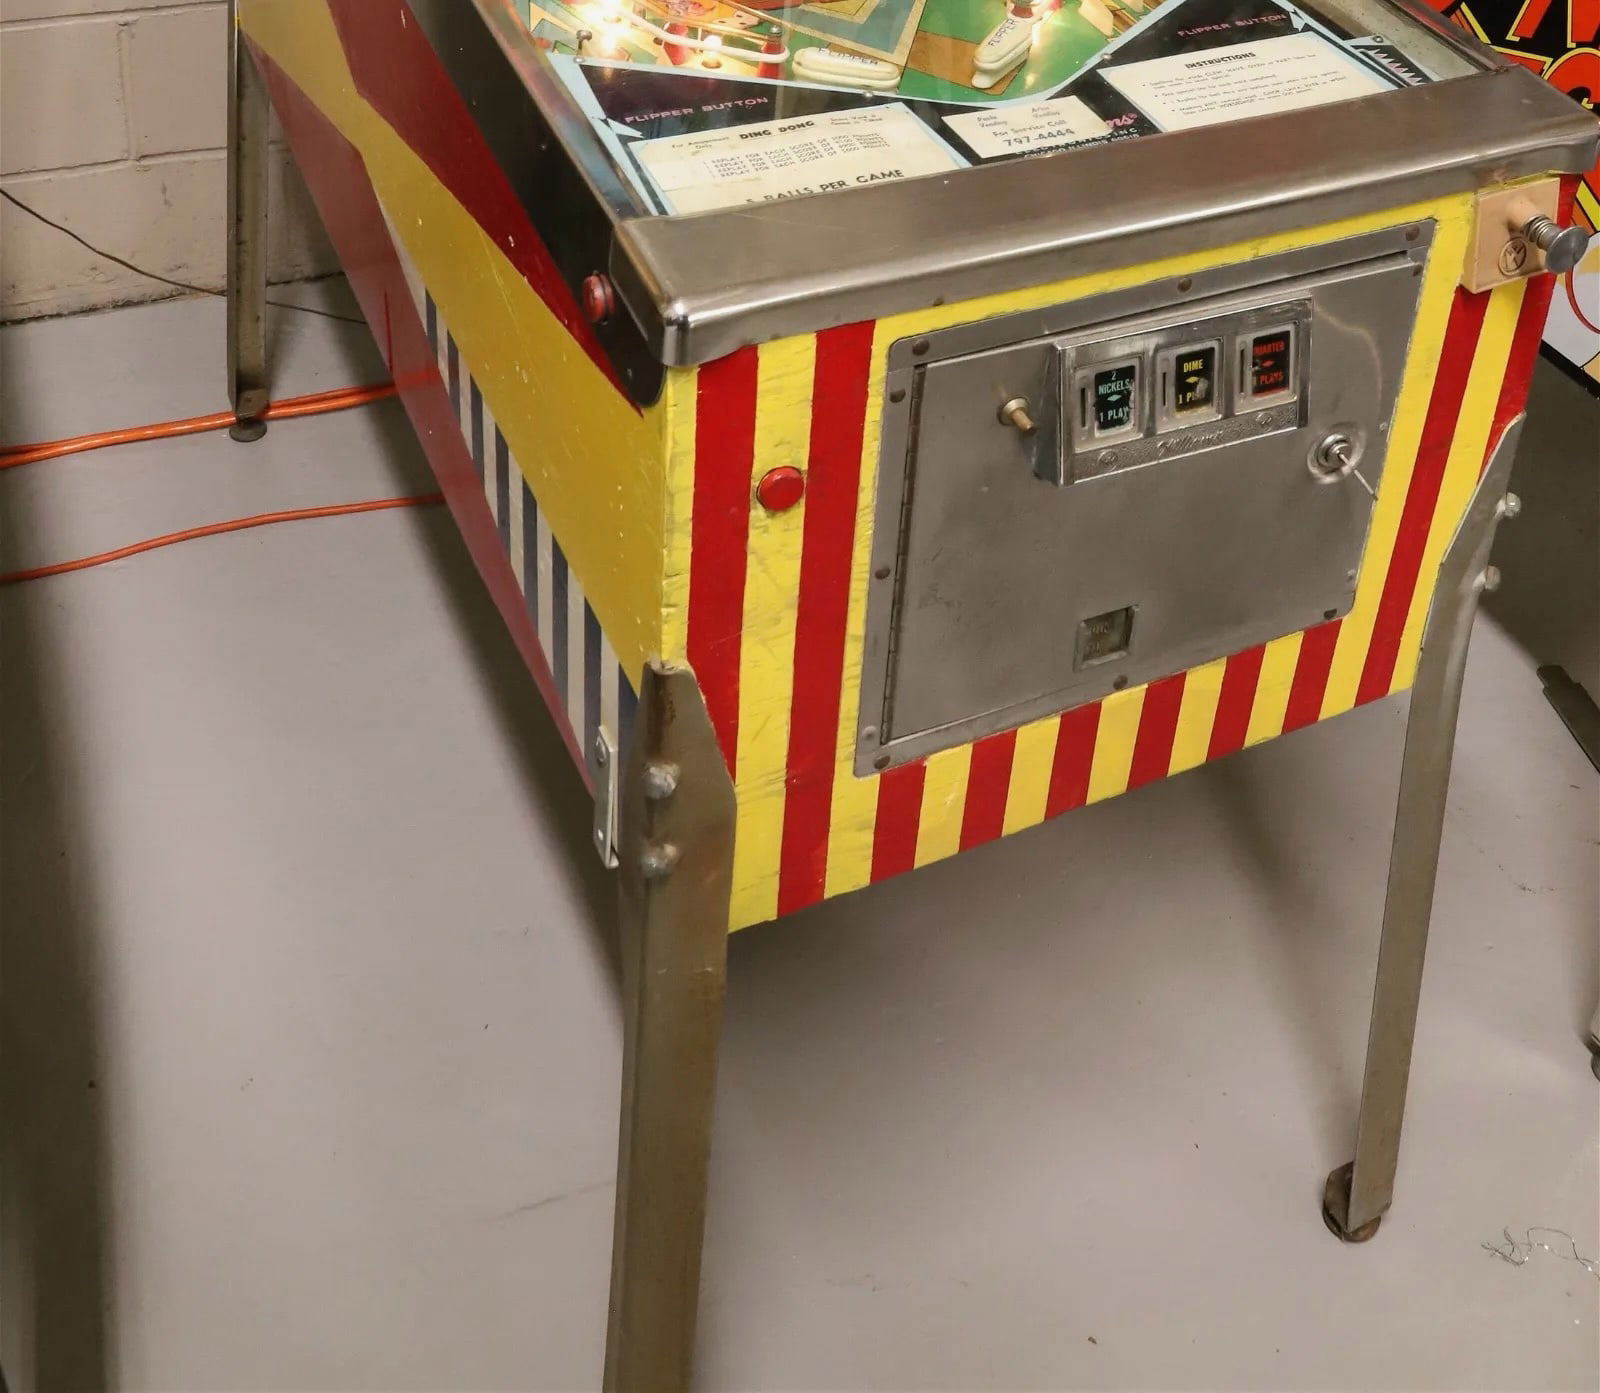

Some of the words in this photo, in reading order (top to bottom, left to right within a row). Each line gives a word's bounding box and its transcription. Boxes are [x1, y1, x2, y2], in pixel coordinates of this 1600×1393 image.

[1178, 23, 1231, 37] FLIPPER
[1235, 14, 1287, 27] BUTTON
[1185, 52, 1256, 68] INSTRUCTIONS
[625, 108, 694, 123] FLIPPER
[701, 97, 768, 112] BUTTON
[740, 129, 772, 140] DING
[778, 121, 816, 133] DONG
[1003, 128, 1075, 146] 797-4444
[819, 180, 849, 192] PER
[856, 169, 905, 183] GAME
[1183, 359, 1204, 373] DIME
[1111, 371, 1117, 380] 2
[1098, 378, 1130, 395] NICKELS
[1178, 394, 1183, 404] 1
[1100, 412, 1104, 422] 1
[1108, 407, 1129, 420] PLAY
